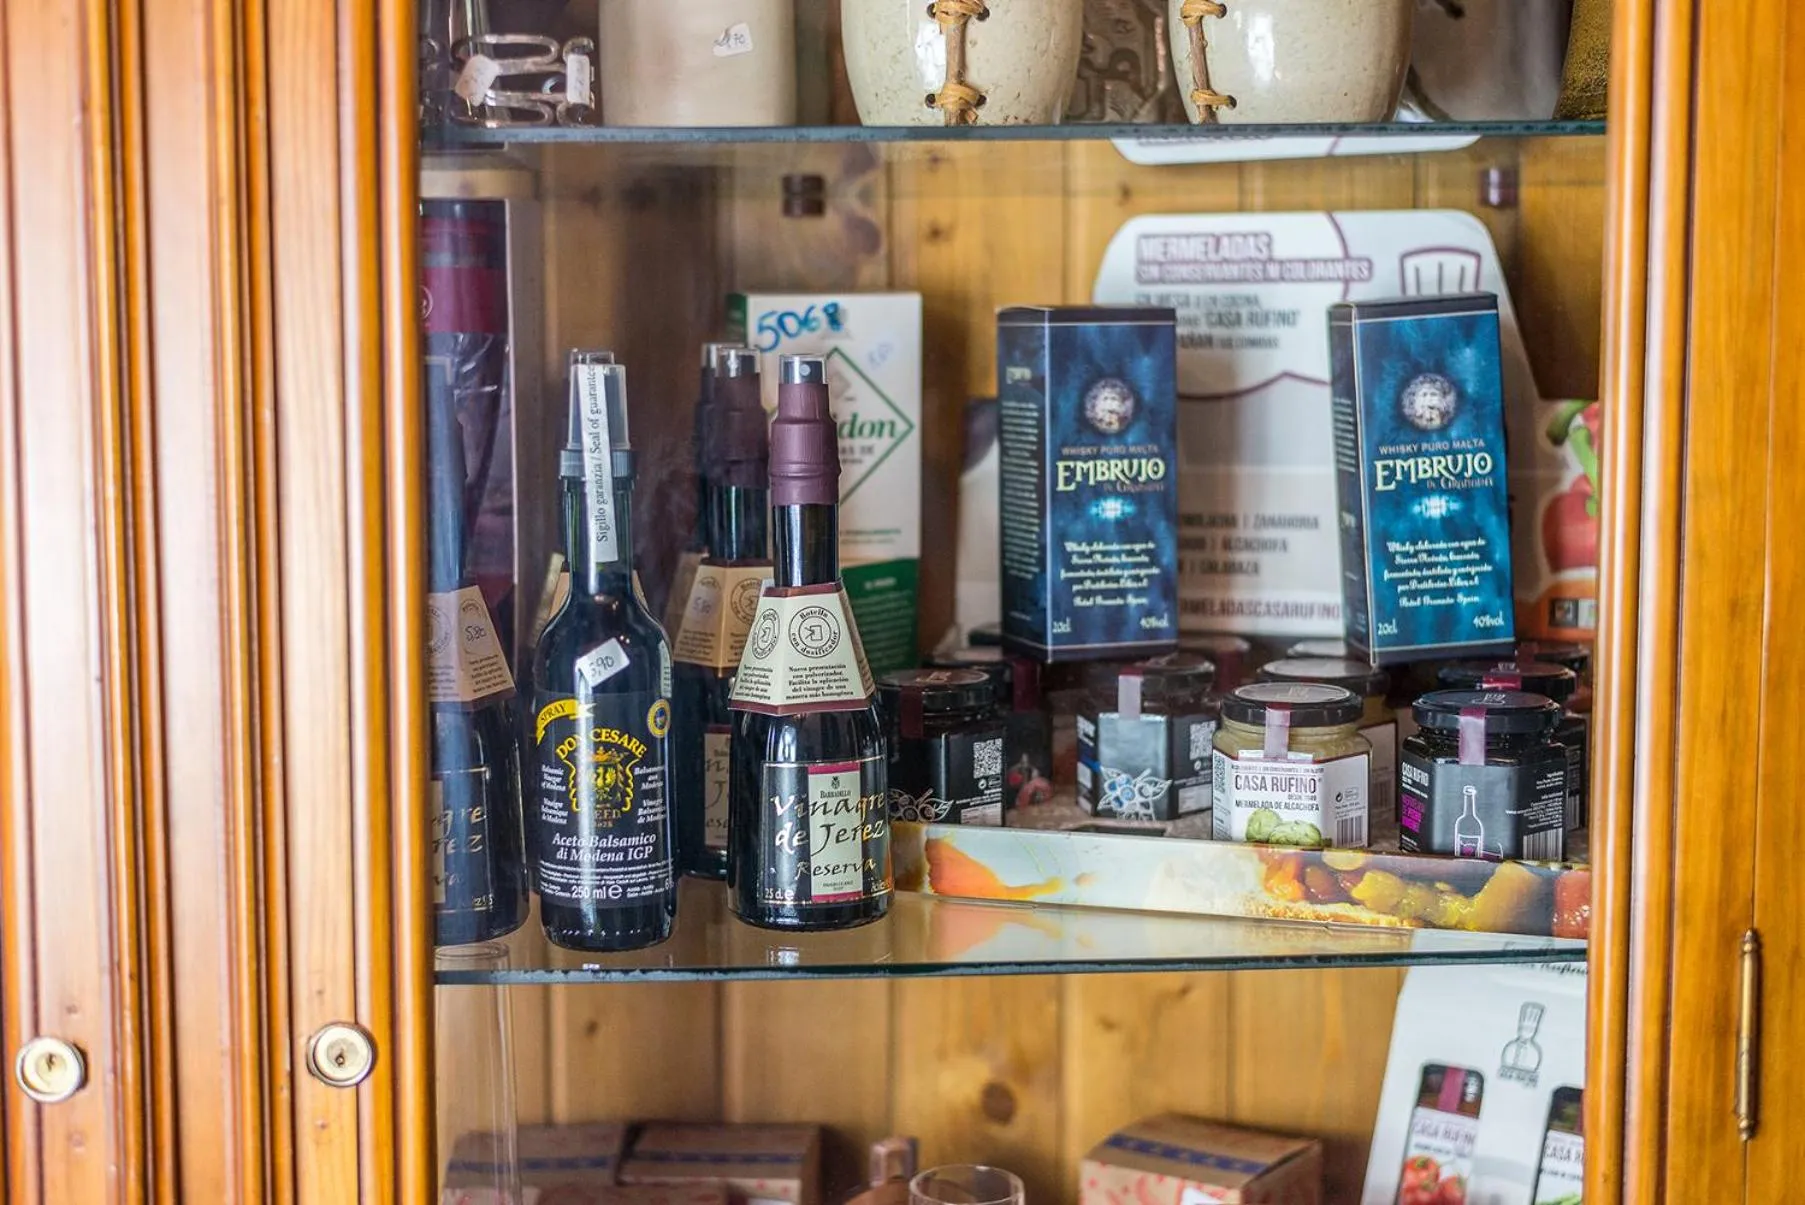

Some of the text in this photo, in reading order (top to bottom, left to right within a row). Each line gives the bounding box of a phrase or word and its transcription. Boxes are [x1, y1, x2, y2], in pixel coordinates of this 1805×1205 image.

[1139, 234, 1271, 260] MERMELADAS
[591, 415, 600, 427] of
[589, 429, 601, 454] Seal
[1062, 444, 1159, 456] WHISKY PURO MALTA
[1379, 438, 1485, 455] WHISKY PURO MALTA
[1056, 458, 1165, 491] EMBRUJO
[1374, 452, 1493, 491] EMBRUJO
[595, 462, 608, 506] garanzia
[597, 508, 611, 543] Sigillo
[800, 608, 829, 620] Botella
[1377, 618, 1398, 636] 20cl
[540, 702, 567, 722] SPRAY
[589, 727, 647, 758] CESARE
[1235, 774, 1317, 794] CASA RUFINO
[770, 791, 885, 823] Vinagre
[1235, 799, 1320, 812] MERMELADA DE ALCACHOFA
[552, 832, 657, 848] Aceto Balsamico
[775, 819, 885, 857] de Jerez
[556, 846, 653, 862] di Modena IGP
[795, 858, 877, 881] Reserva
[571, 886, 591, 899] 250
[593, 886, 607, 899] ml
